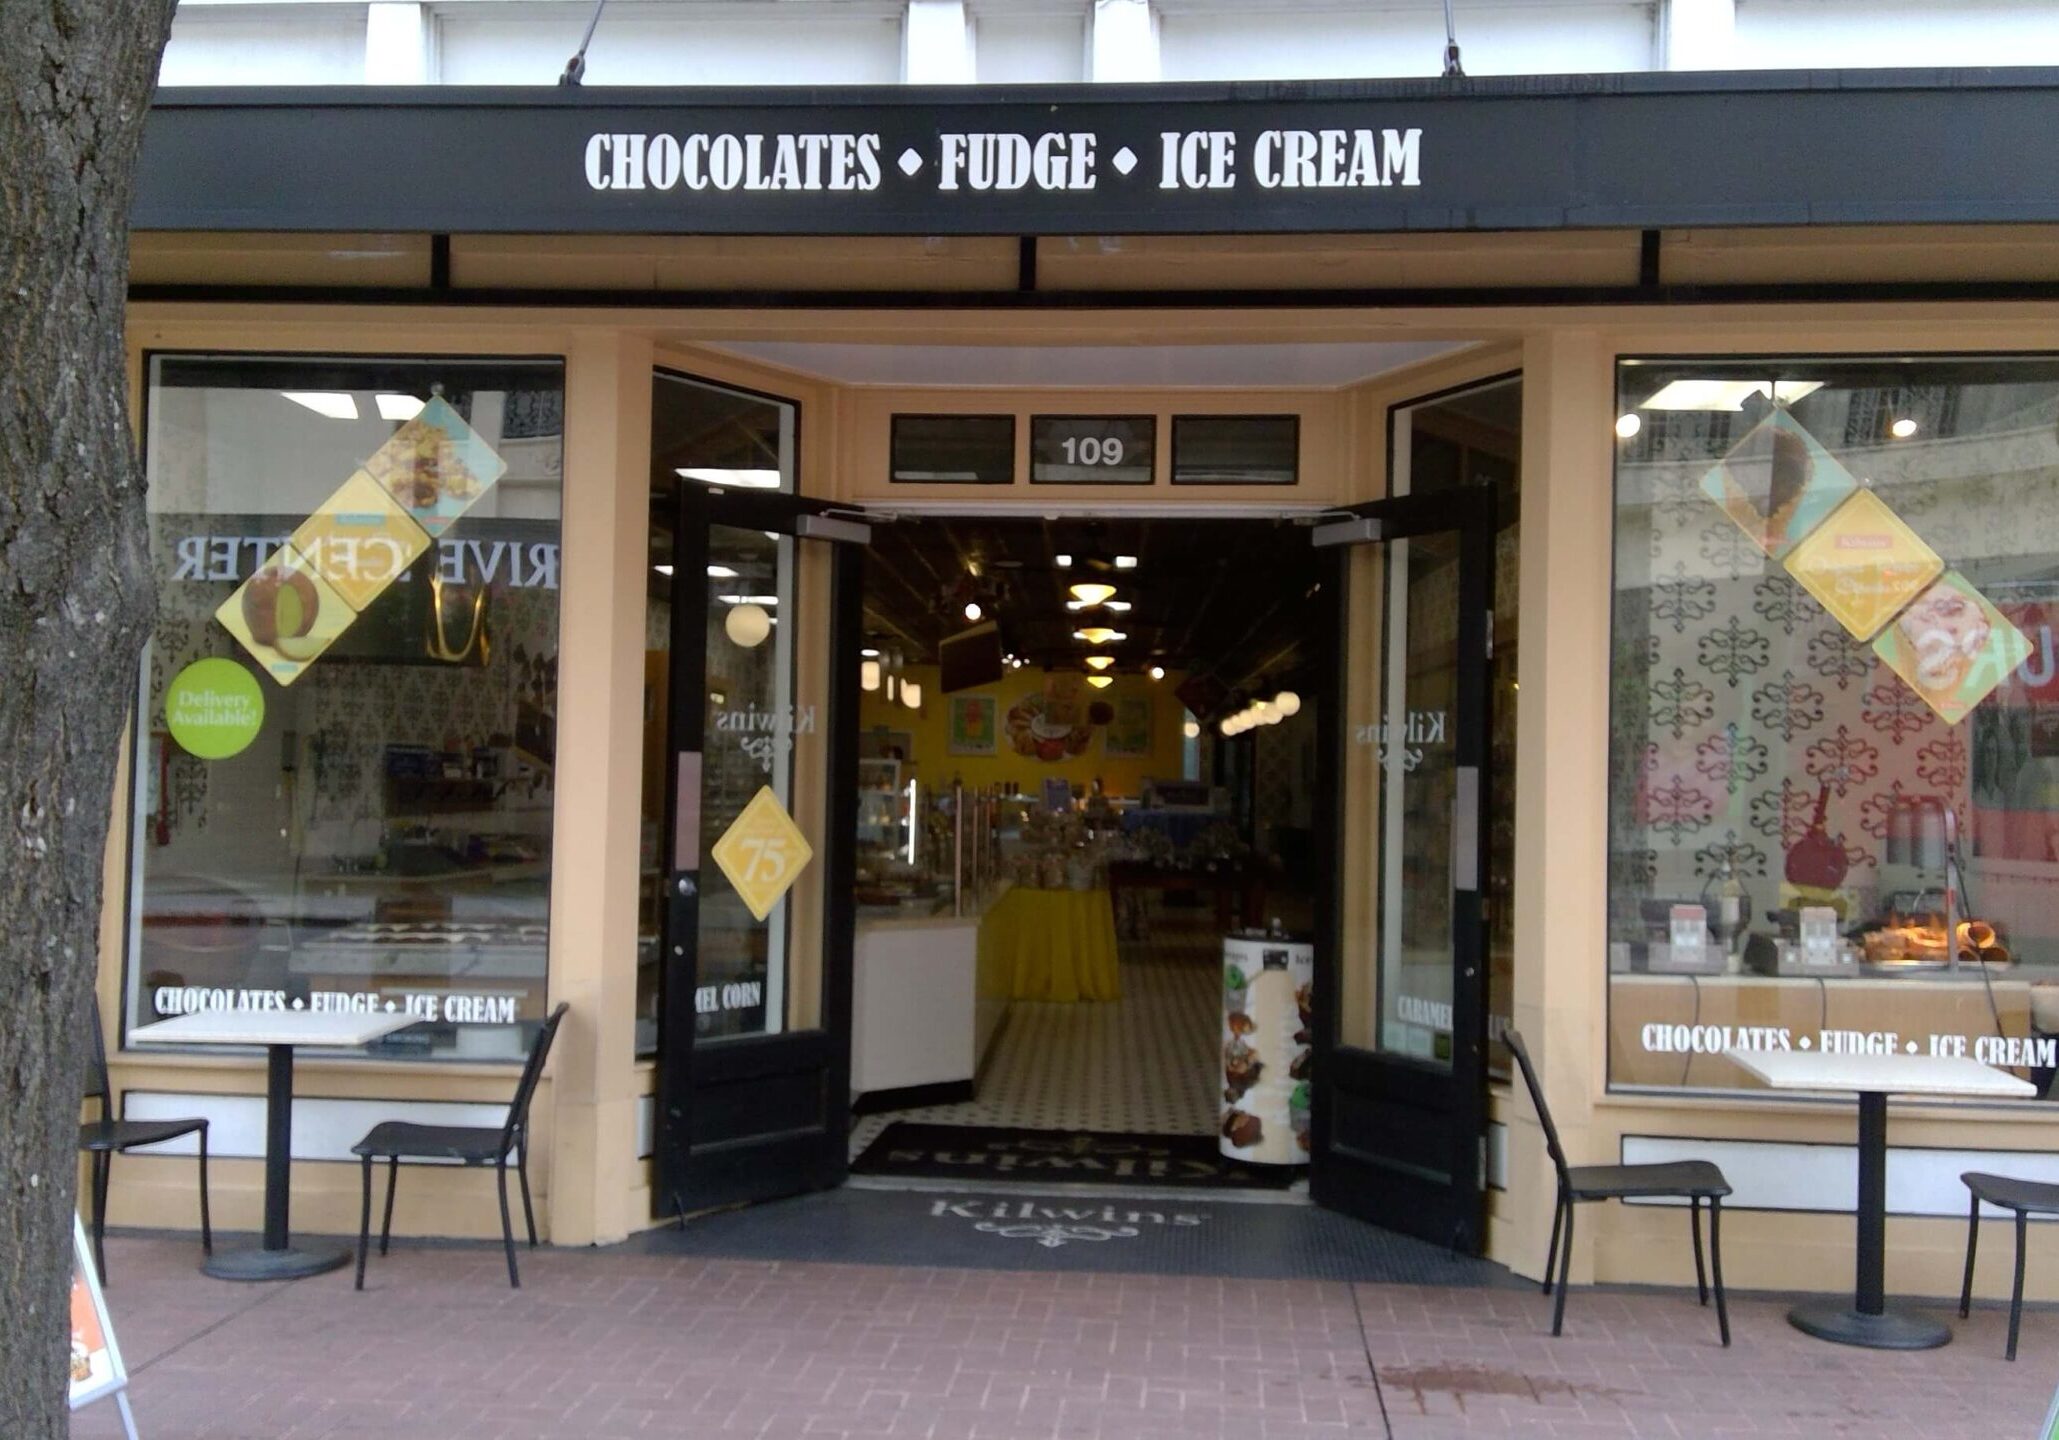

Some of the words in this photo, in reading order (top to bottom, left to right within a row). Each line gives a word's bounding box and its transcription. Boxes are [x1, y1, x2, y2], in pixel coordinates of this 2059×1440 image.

[585, 133, 881, 190] CHOCOLATES
[938, 132, 1097, 190] FUDGE
[1159, 131, 1236, 189] ICE
[1254, 128, 1422, 188] CREAM
[1061, 437, 1124, 465] 109
[178, 690, 251, 712] Delivery
[172, 708, 257, 728] Available!
[740, 838, 787, 883] 75
[155, 986, 286, 1015] CHOCOLATES
[310, 991, 380, 1014] FUDGE
[404, 993, 438, 1021] ICE
[444, 995, 516, 1023] CREAM
[723, 981, 761, 1011] CORN
[1397, 995, 1453, 1031] CARAME
[1641, 1023, 1791, 1054] CHOCOLATES
[1820, 1029, 1898, 1056] FUDGE
[1930, 1034, 1966, 1058] ICE
[1975, 1036, 2057, 1068] CREAM
[930, 1200, 1203, 1226] Kilwins
